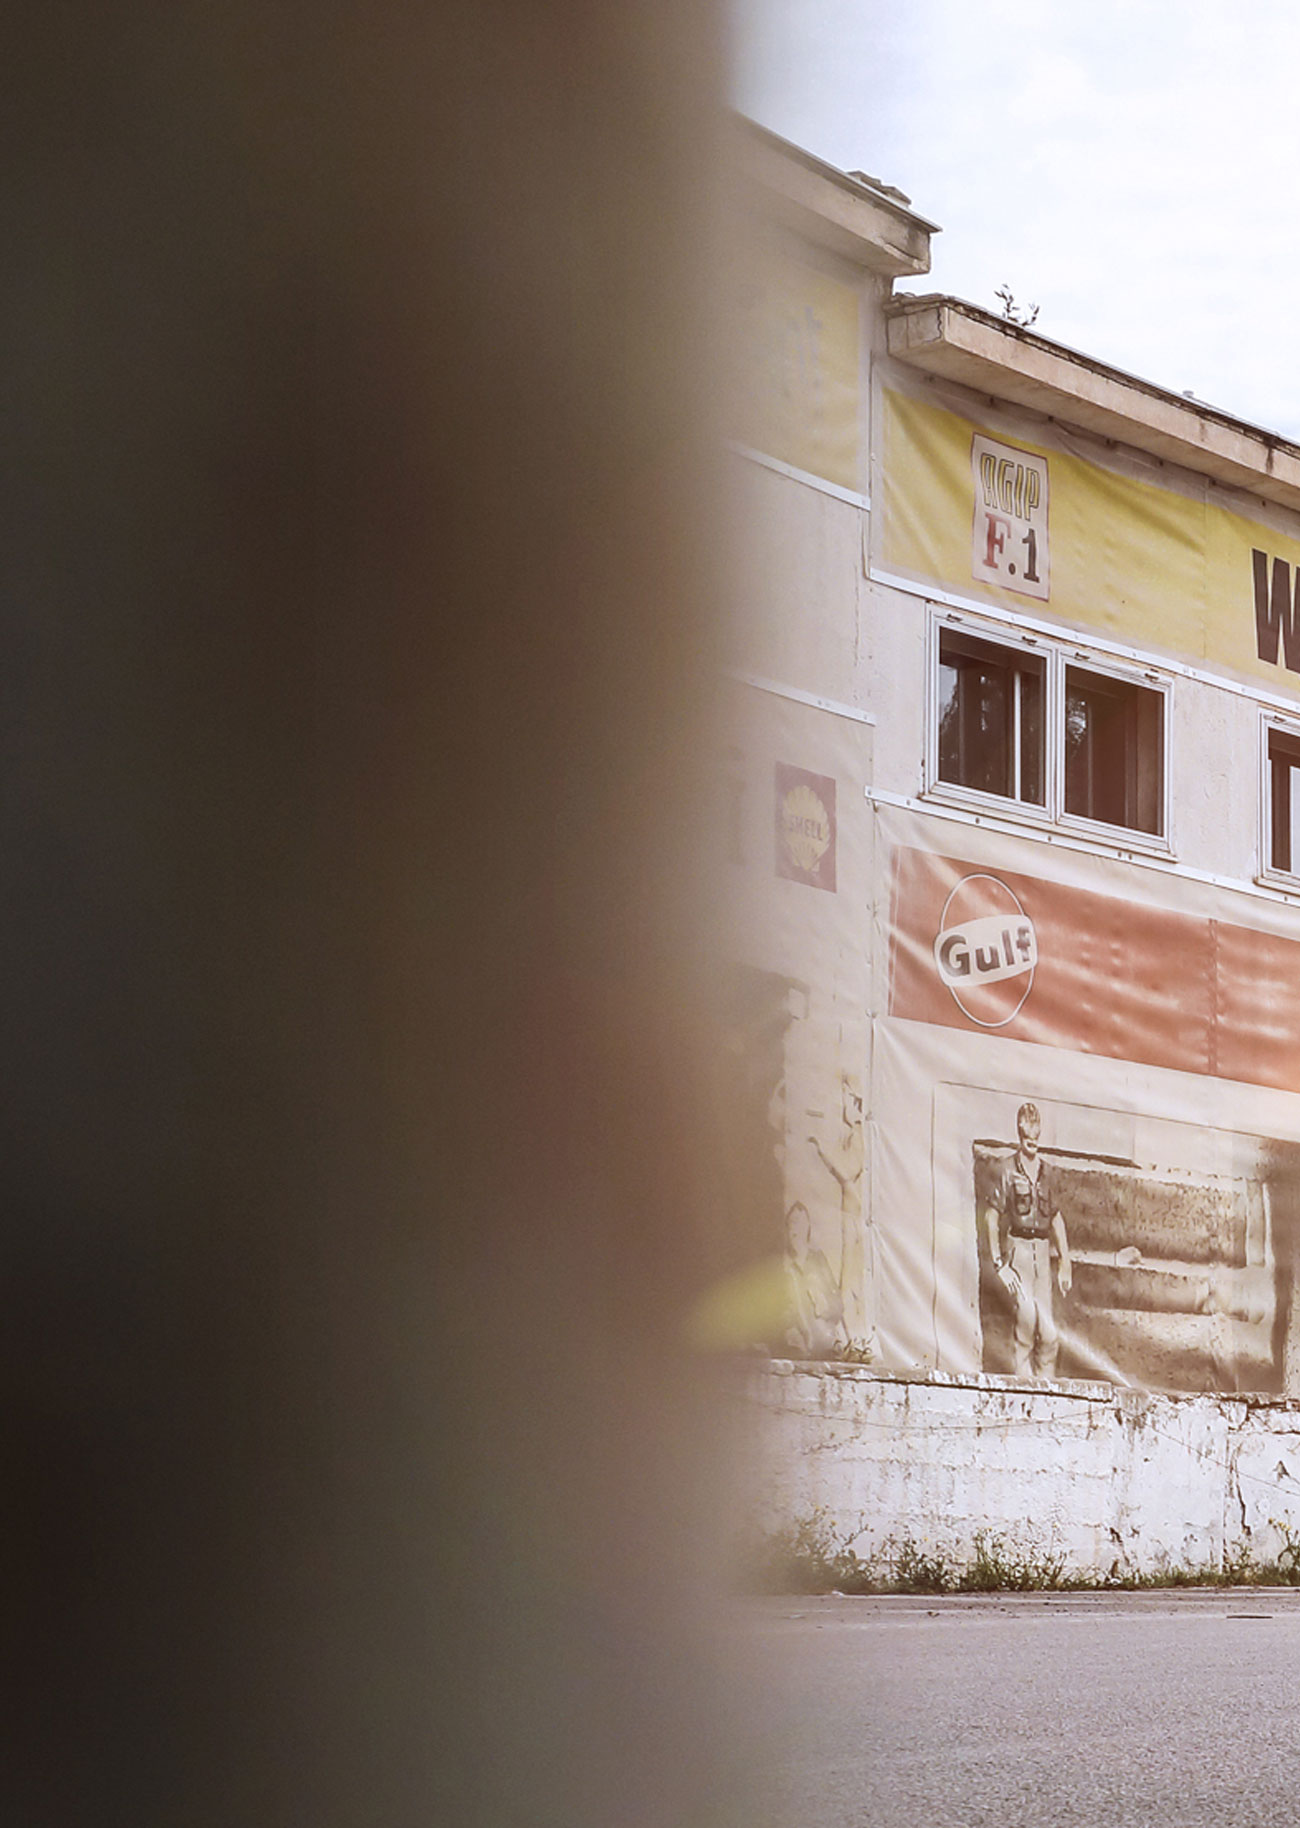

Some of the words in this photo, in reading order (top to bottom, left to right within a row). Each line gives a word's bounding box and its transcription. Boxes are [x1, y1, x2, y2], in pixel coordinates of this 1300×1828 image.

[980, 452, 1040, 521] AGIP
[983, 512, 1040, 583] F.1
[940, 925, 1031, 978] Gulf
